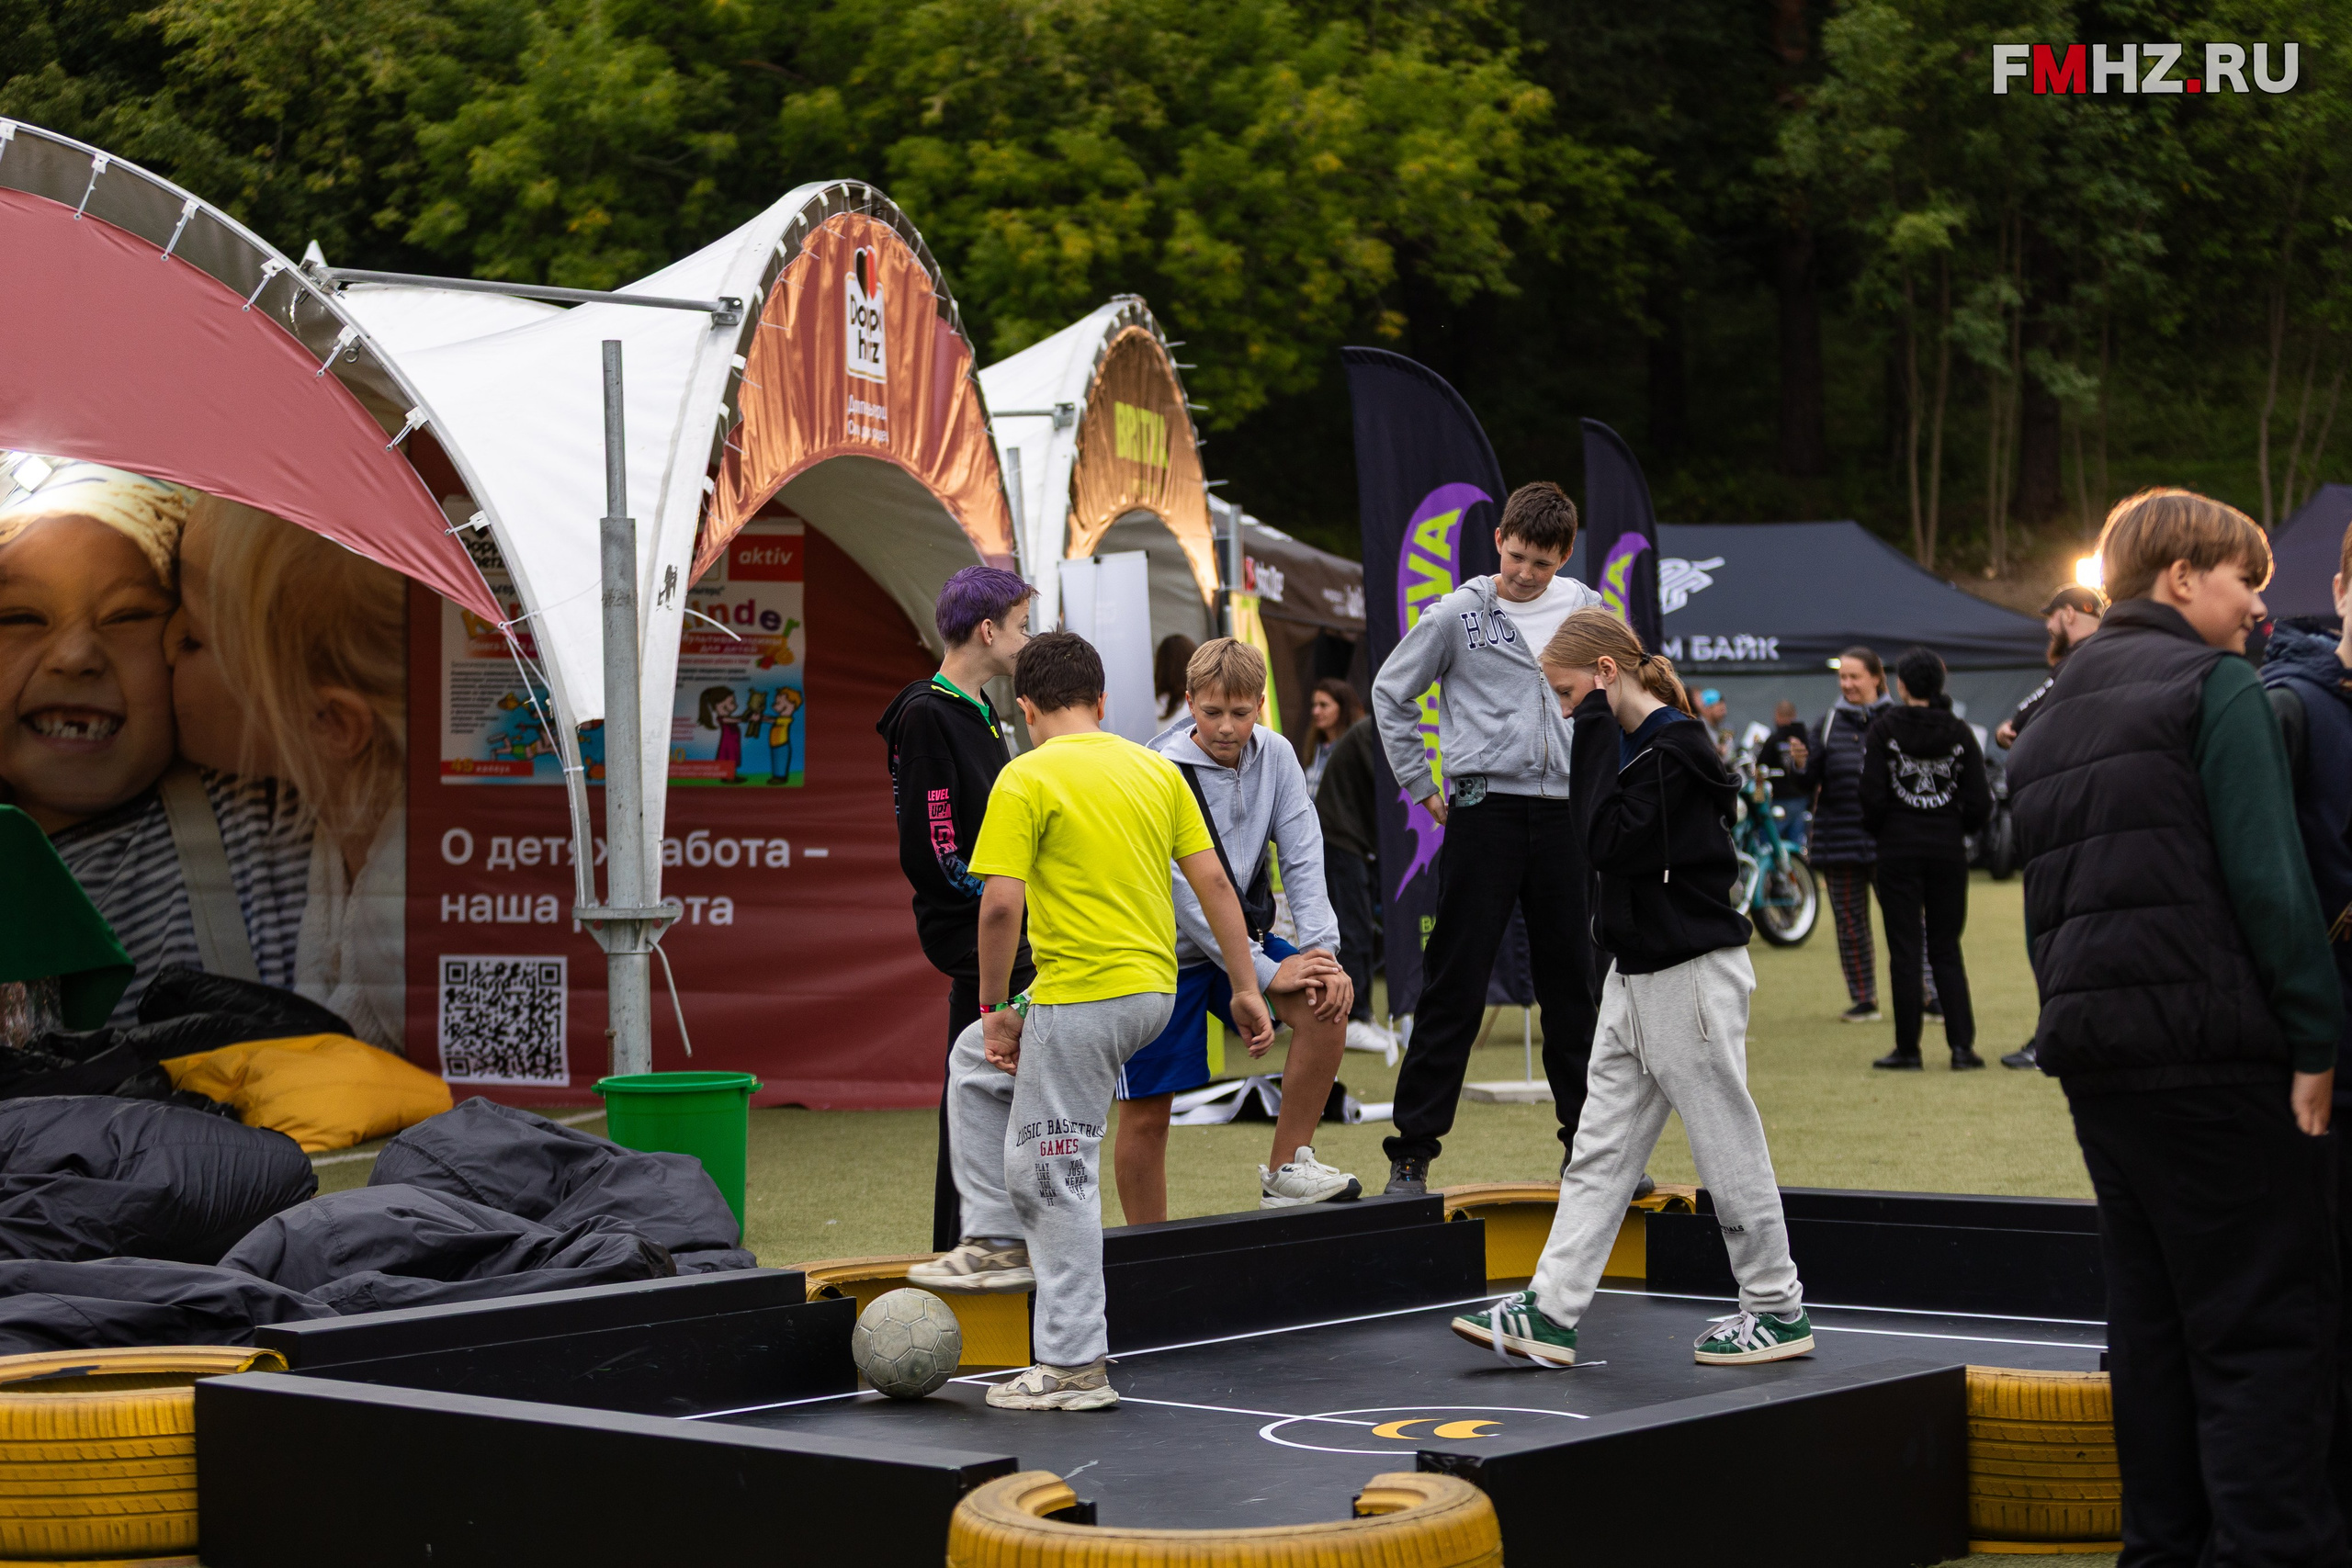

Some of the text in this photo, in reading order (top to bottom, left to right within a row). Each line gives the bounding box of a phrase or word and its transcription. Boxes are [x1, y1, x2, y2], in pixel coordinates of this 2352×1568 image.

[739, 547, 793, 566] aktiv
[684, 598, 800, 637] inder
[1689, 634, 1781, 661] БАЙК
[927, 788, 950, 802] LEVEL
[441, 828, 474, 865] О
[487, 836, 609, 871] детх
[661, 830, 791, 868] абота
[441, 894, 559, 924] наша
[1040, 1138, 1080, 1156] GAMES
[1035, 1163, 1049, 1172] PLAY
[1070, 1158, 1083, 1168] YOU
[1036, 1172, 1051, 1181] LIKE
[1068, 1167, 1086, 1177] JUST
[1065, 1175, 1088, 1187] NEVER
[1039, 1189, 1057, 1198] MEAN
[1069, 1185, 1084, 1194] GIVE
[1047, 1198, 1055, 1206] IT
